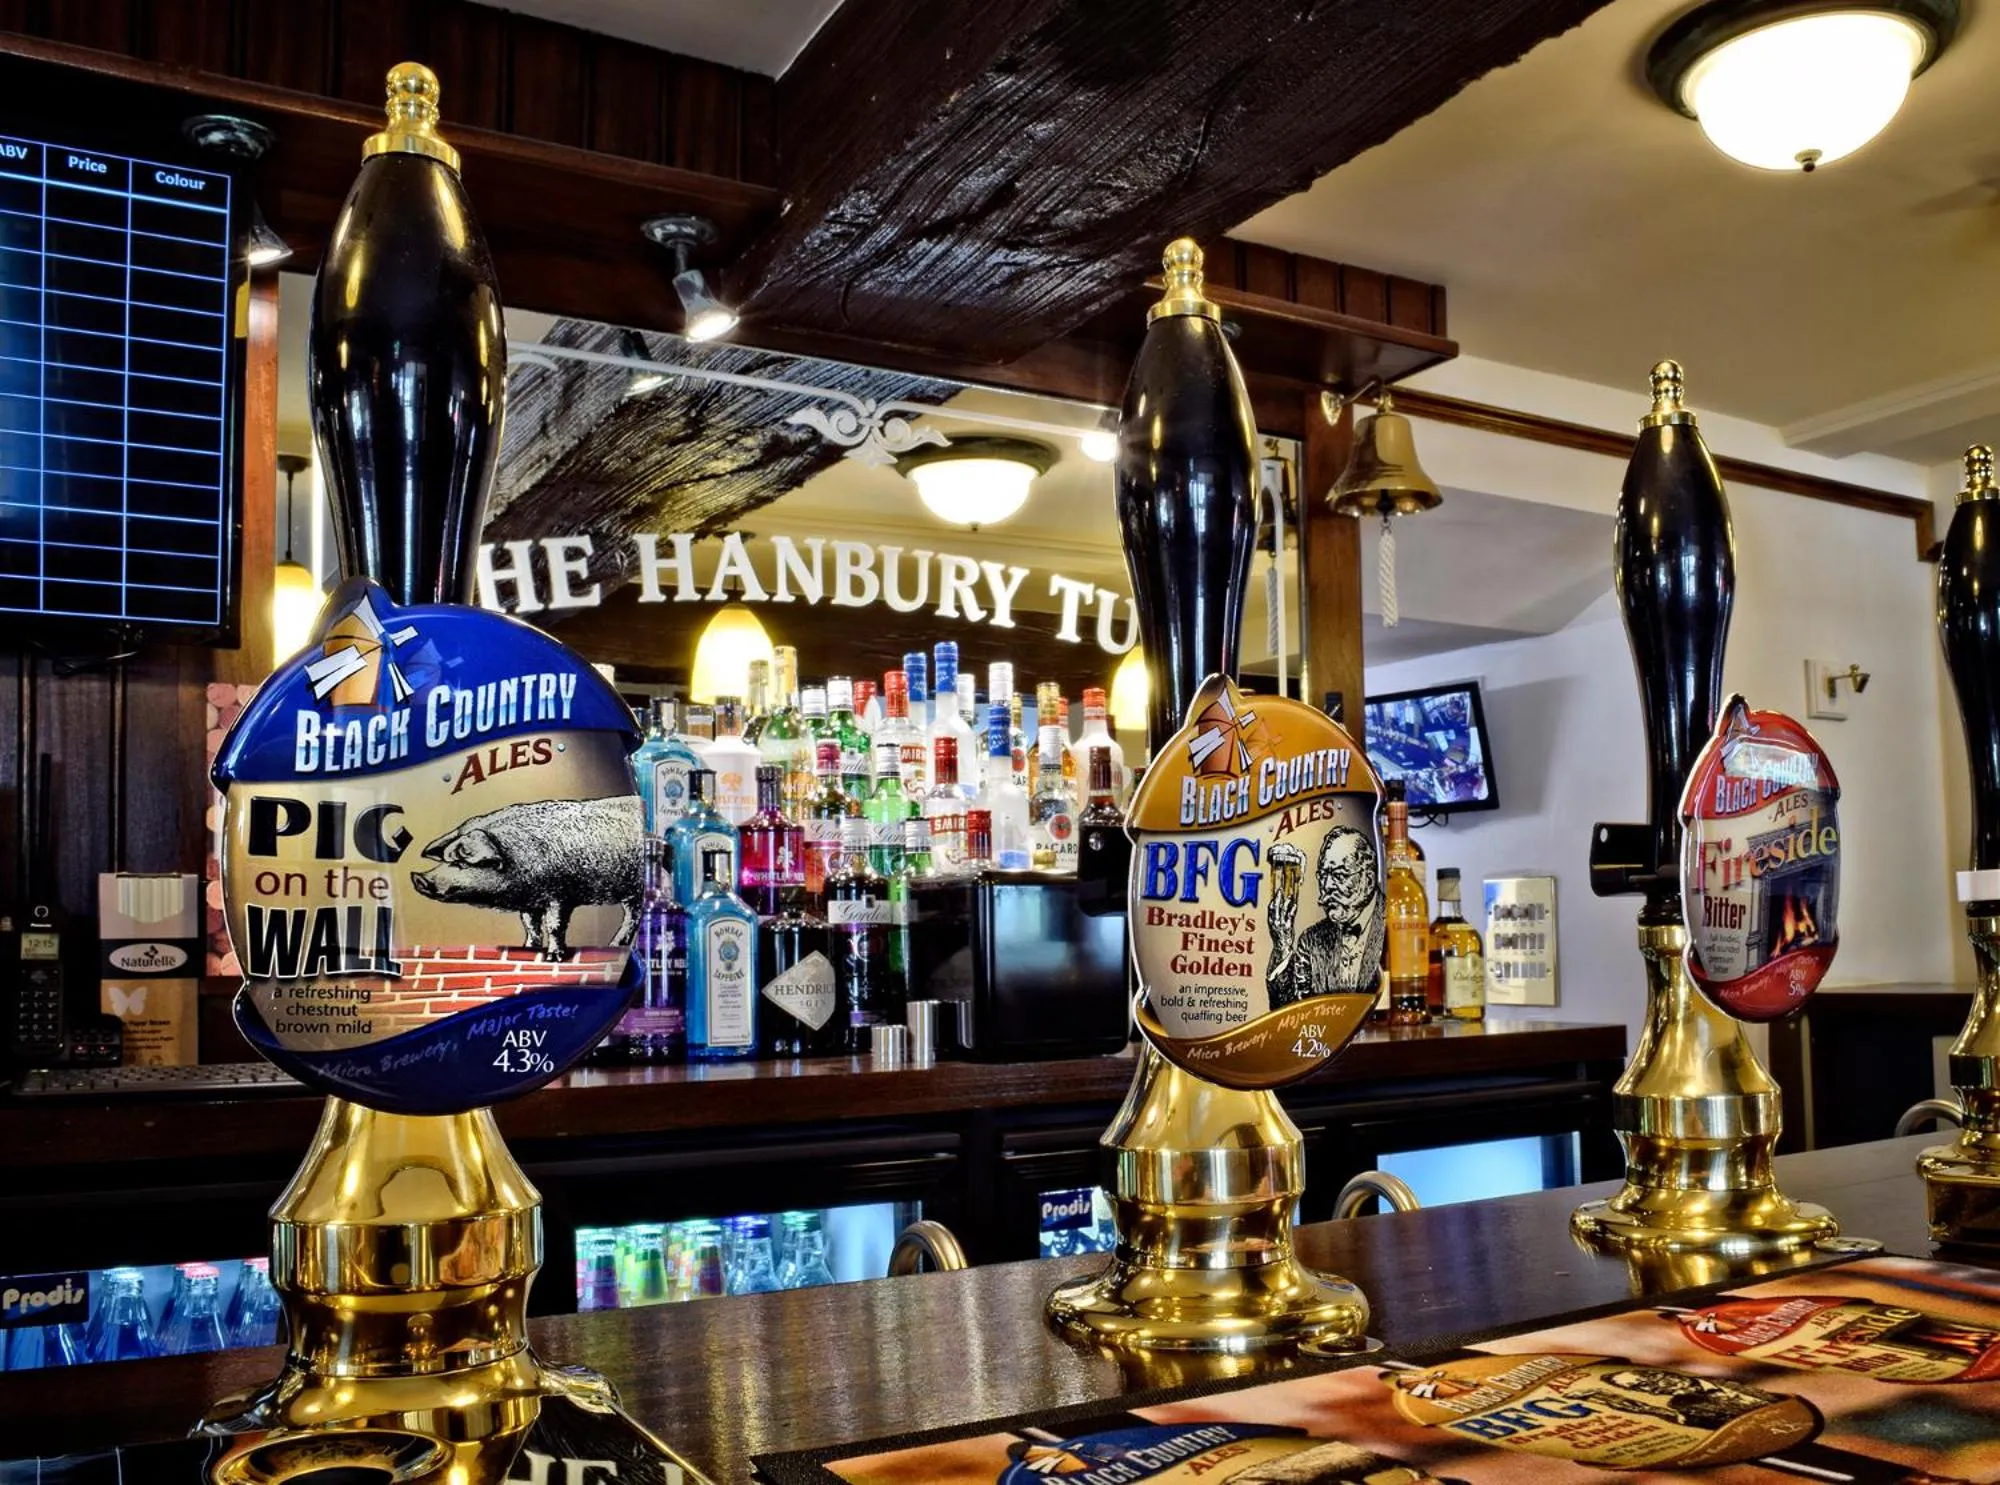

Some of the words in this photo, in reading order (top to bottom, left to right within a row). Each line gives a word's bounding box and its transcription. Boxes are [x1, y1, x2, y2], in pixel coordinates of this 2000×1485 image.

[68, 155, 108, 174] Price
[155, 171, 206, 190] Colour
[638, 531, 1029, 629] HANBURY
[295, 707, 411, 772] BLACK
[426, 673, 577, 748] COUNTRY
[451, 738, 552, 795] ALES
[1180, 775, 1250, 825] BLACK
[1258, 748, 1350, 807] COUNTRY
[1716, 775, 1757, 814] BLACK
[1273, 800, 1334, 841] ALES
[1773, 793, 1809, 823] ALES
[248, 796, 414, 863] PIG
[1692, 808, 1838, 894] Fireside
[255, 871, 307, 897] on
[324, 866, 389, 899] the
[1142, 837, 1263, 908] BFG
[1146, 906, 1256, 936] Bradley's
[1703, 896, 1746, 930] Bitter
[246, 903, 403, 979] WALL
[714, 926, 743, 939] BOMBAY
[1181, 931, 1255, 955] Finest
[1170, 954, 1253, 977] Golden
[274, 987, 282, 998] a
[289, 985, 371, 1001] refreshing
[1160, 995, 1184, 1008] bold
[1187, 997, 1195, 1007] &
[1199, 996, 1248, 1011] refreshing
[1178, 985, 1191, 994] an
[1194, 984, 1249, 998] impressive,
[286, 1003, 358, 1016] chestnut
[467, 1014, 522, 1040] Major
[526, 1004, 580, 1020] Taste!
[1181, 1011, 1223, 1024] quaffing
[1225, 1011, 1248, 1022] beer
[275, 1020, 330, 1034] brown
[336, 1020, 372, 1034] mild
[502, 1030, 548, 1048] ABV
[1187, 1047, 1221, 1060] Micro
[1224, 1030, 1272, 1056] Brewery,
[1277, 1012, 1310, 1031] Major
[1298, 1024, 1326, 1038] ABV
[493, 1049, 555, 1073] 4.3%
[1292, 1038, 1331, 1058] 4.2%
[1042, 1194, 1090, 1221] Prodis
[2, 1278, 84, 1314] Prodis
[1450, 1396, 1603, 1440] BFG
[1124, 1425, 1237, 1471] COUNTRY
[1187, 1445, 1251, 1476] ALES
